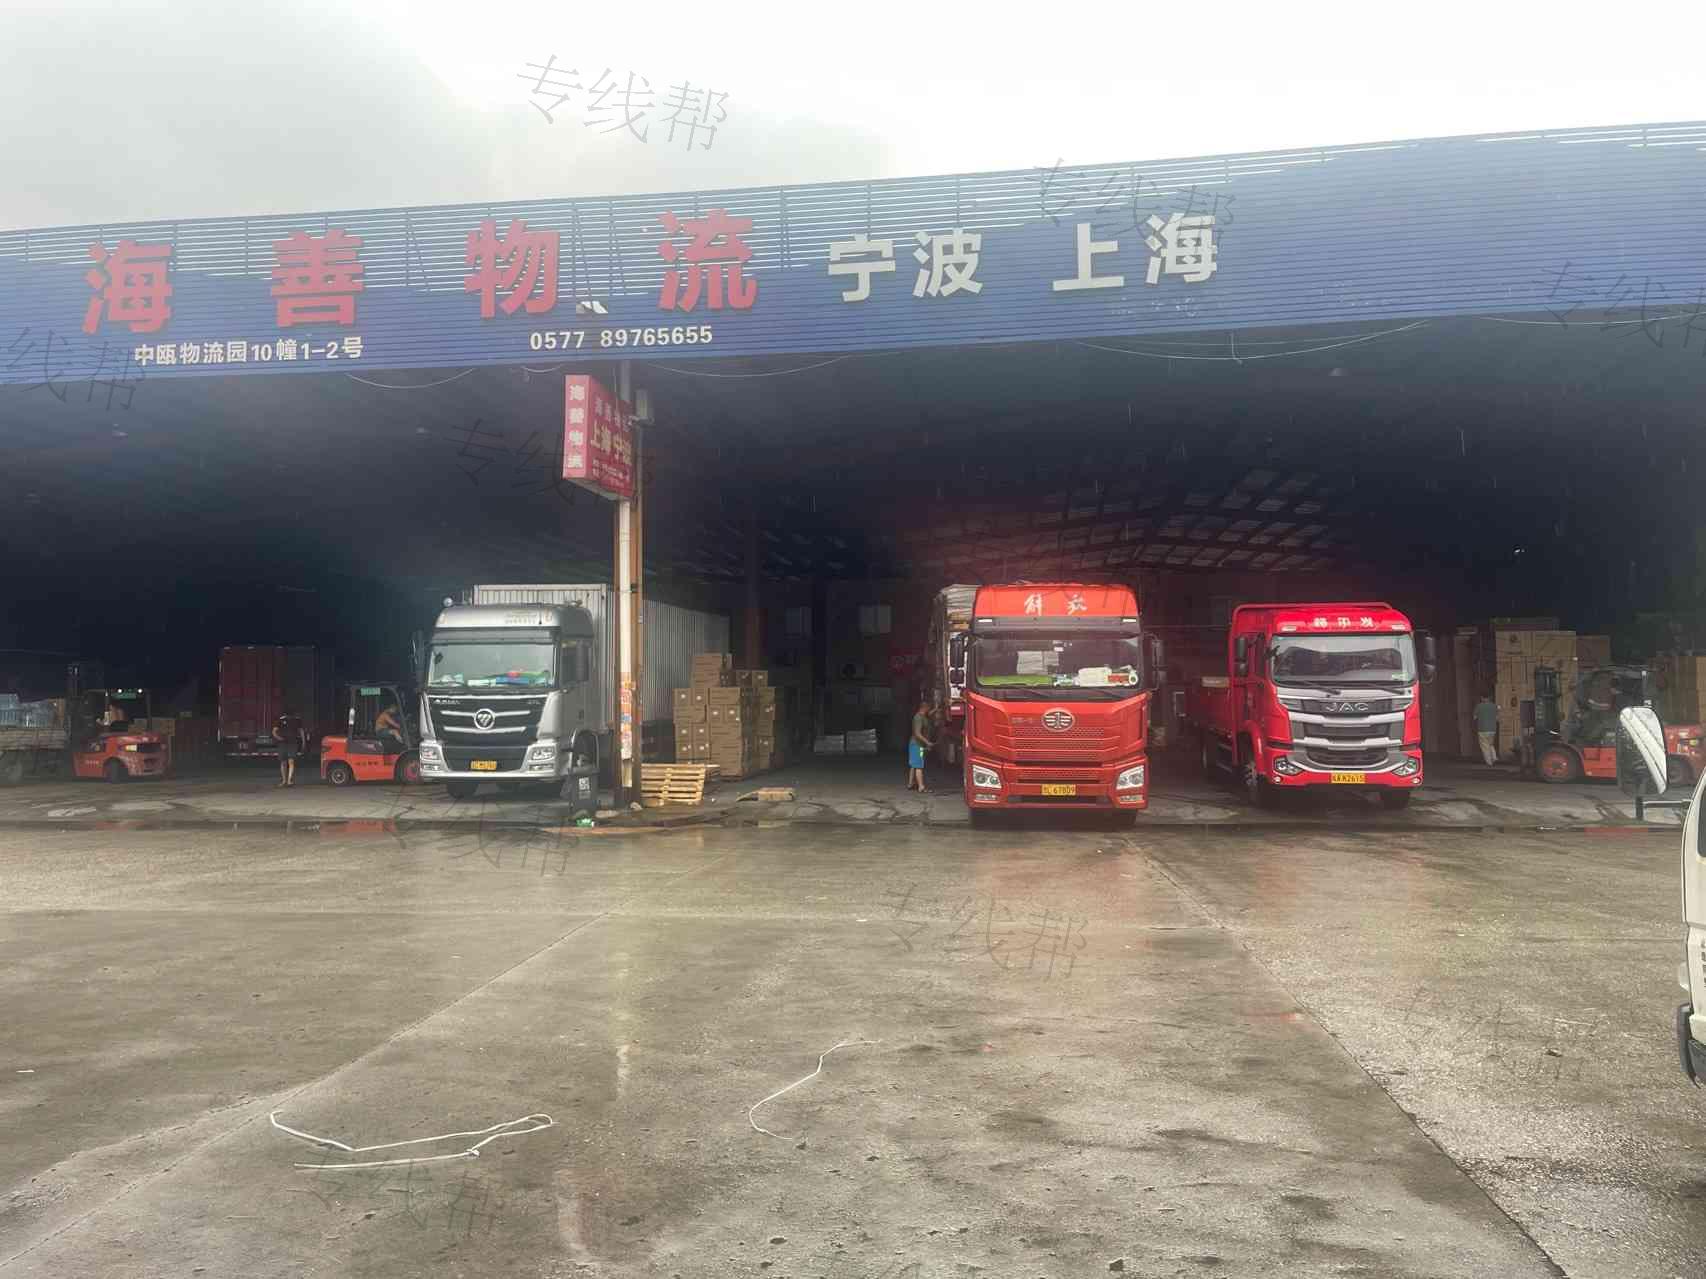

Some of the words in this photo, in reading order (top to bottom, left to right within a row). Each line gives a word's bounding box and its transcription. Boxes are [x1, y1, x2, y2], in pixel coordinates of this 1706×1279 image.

[828, 228, 984, 302] 宁波
[1052, 212, 1218, 291] 上海
[83, 208, 758, 334] 海善物流
[529, 330, 586, 350] 0577
[600, 325, 713, 348] 89765655
[1023, 593, 1088, 616] 解放
[1325, 703, 1369, 712] JAC
